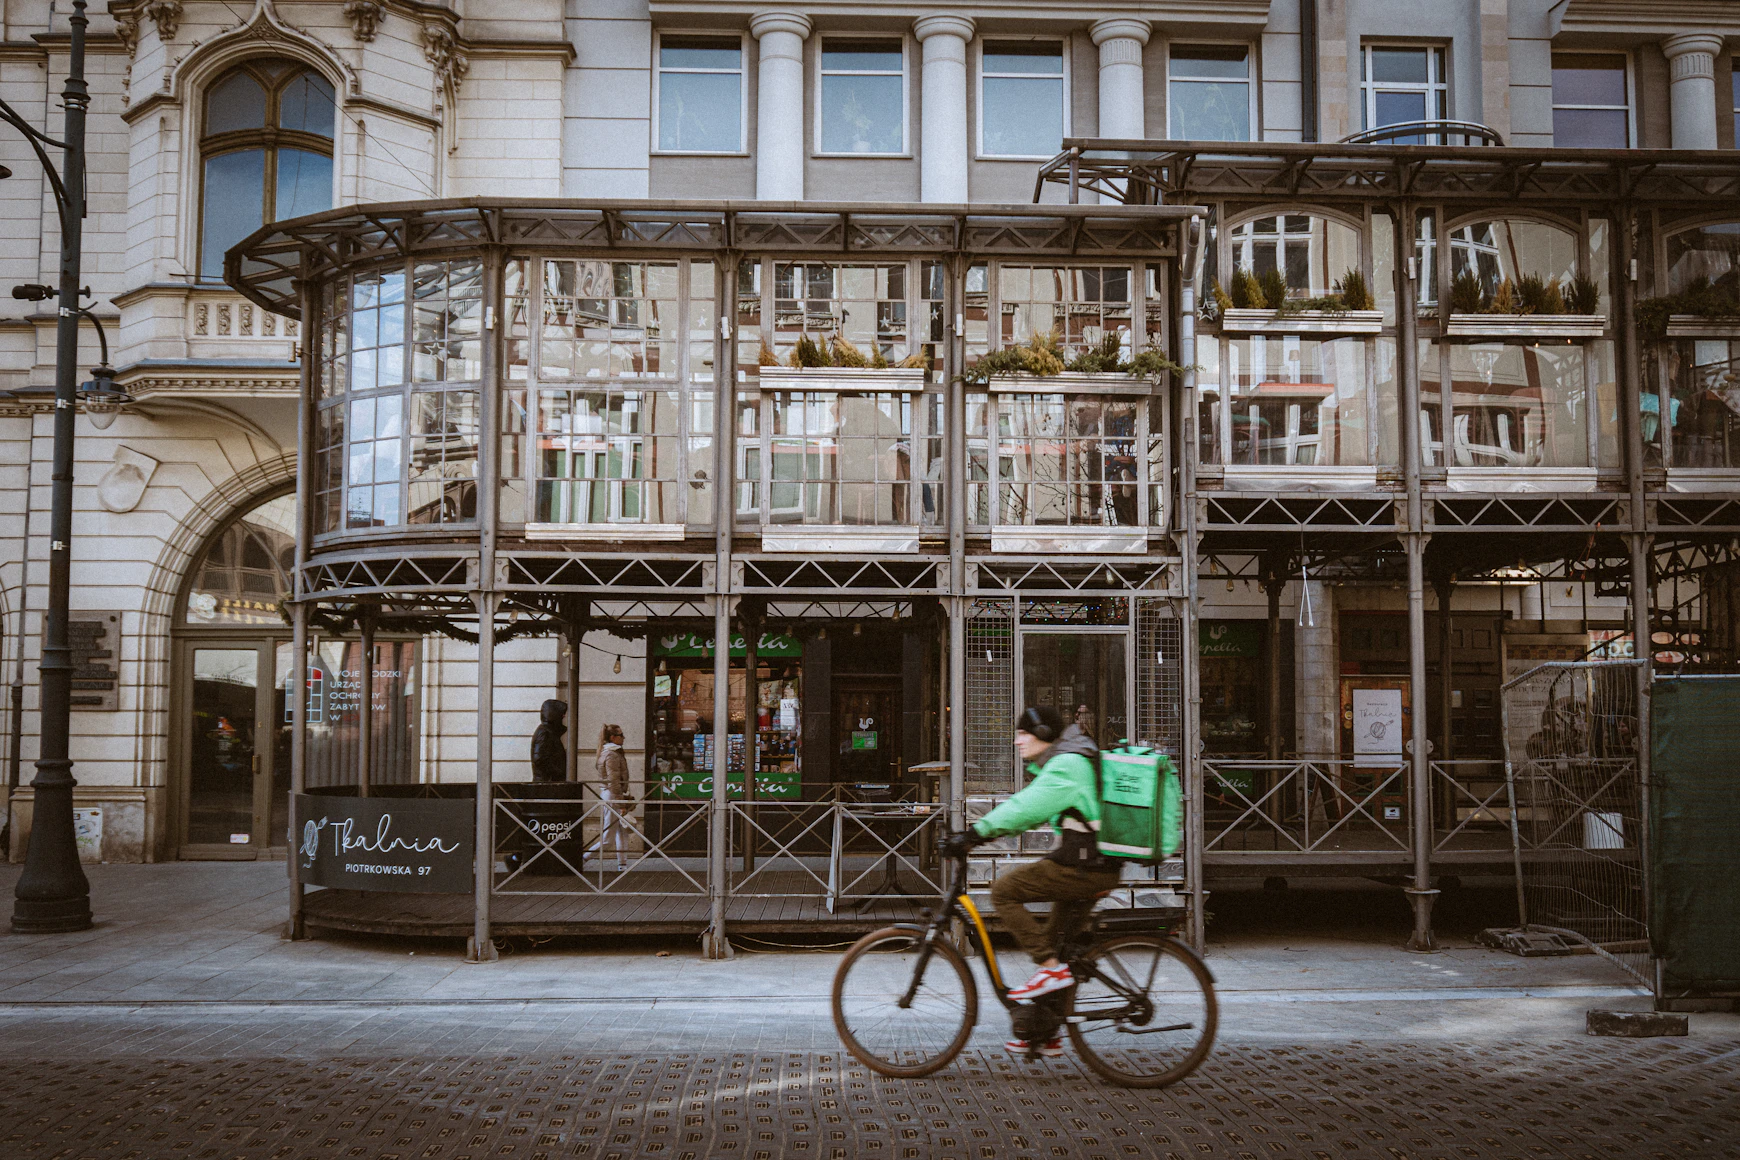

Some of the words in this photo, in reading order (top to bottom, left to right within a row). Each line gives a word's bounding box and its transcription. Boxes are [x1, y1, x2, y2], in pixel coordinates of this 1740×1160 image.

[1199, 642, 1241, 654] epelia
[329, 703, 386, 711] ZABYTW
[541, 820, 572, 833] pepsi
[330, 813, 460, 857] Tkalnia
[345, 863, 412, 875] PIOTRKOWSKA
[417, 866, 432, 876] 97
